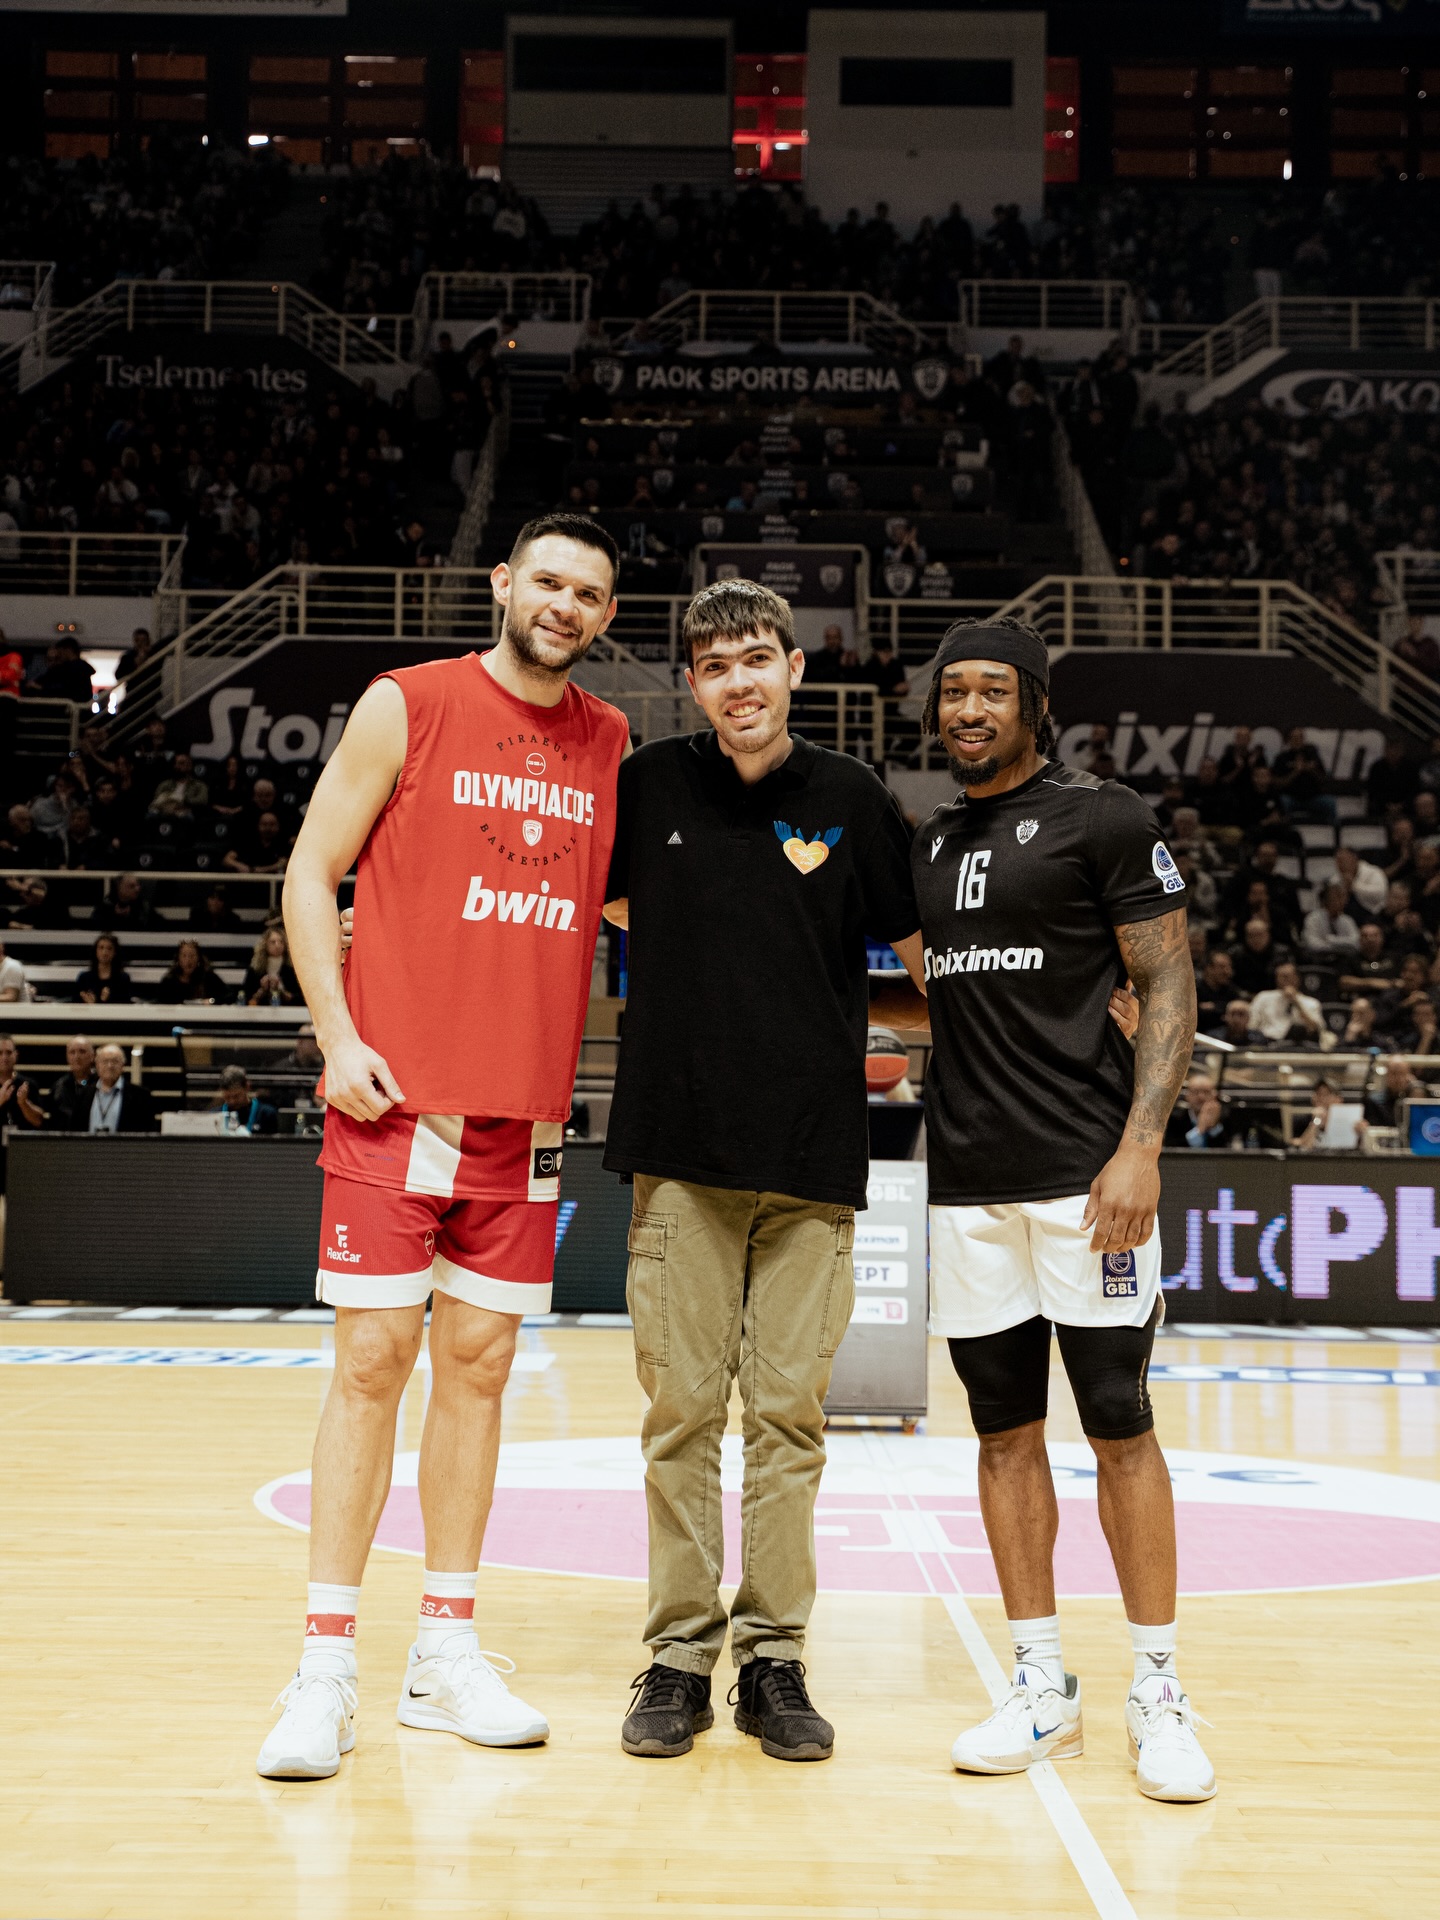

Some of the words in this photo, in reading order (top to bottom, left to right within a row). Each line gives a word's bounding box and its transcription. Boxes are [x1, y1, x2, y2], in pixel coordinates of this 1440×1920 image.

[635, 365, 703, 391] PAOK
[709, 366, 809, 392] SPORTS
[812, 367, 901, 393] ARENA
[189, 686, 349, 764] Stoi
[496, 734, 568, 762] PIRAEUS
[453, 770, 595, 827] OLYMPIACOS
[480, 823, 577, 867] BASKETBALL
[955, 850, 992, 911] 16
[461, 875, 576, 931] bwin
[923, 945, 1044, 983] Stoiximan
[326, 1246, 362, 1264] FlexCar
[1105, 1282, 1136, 1295] GBL
